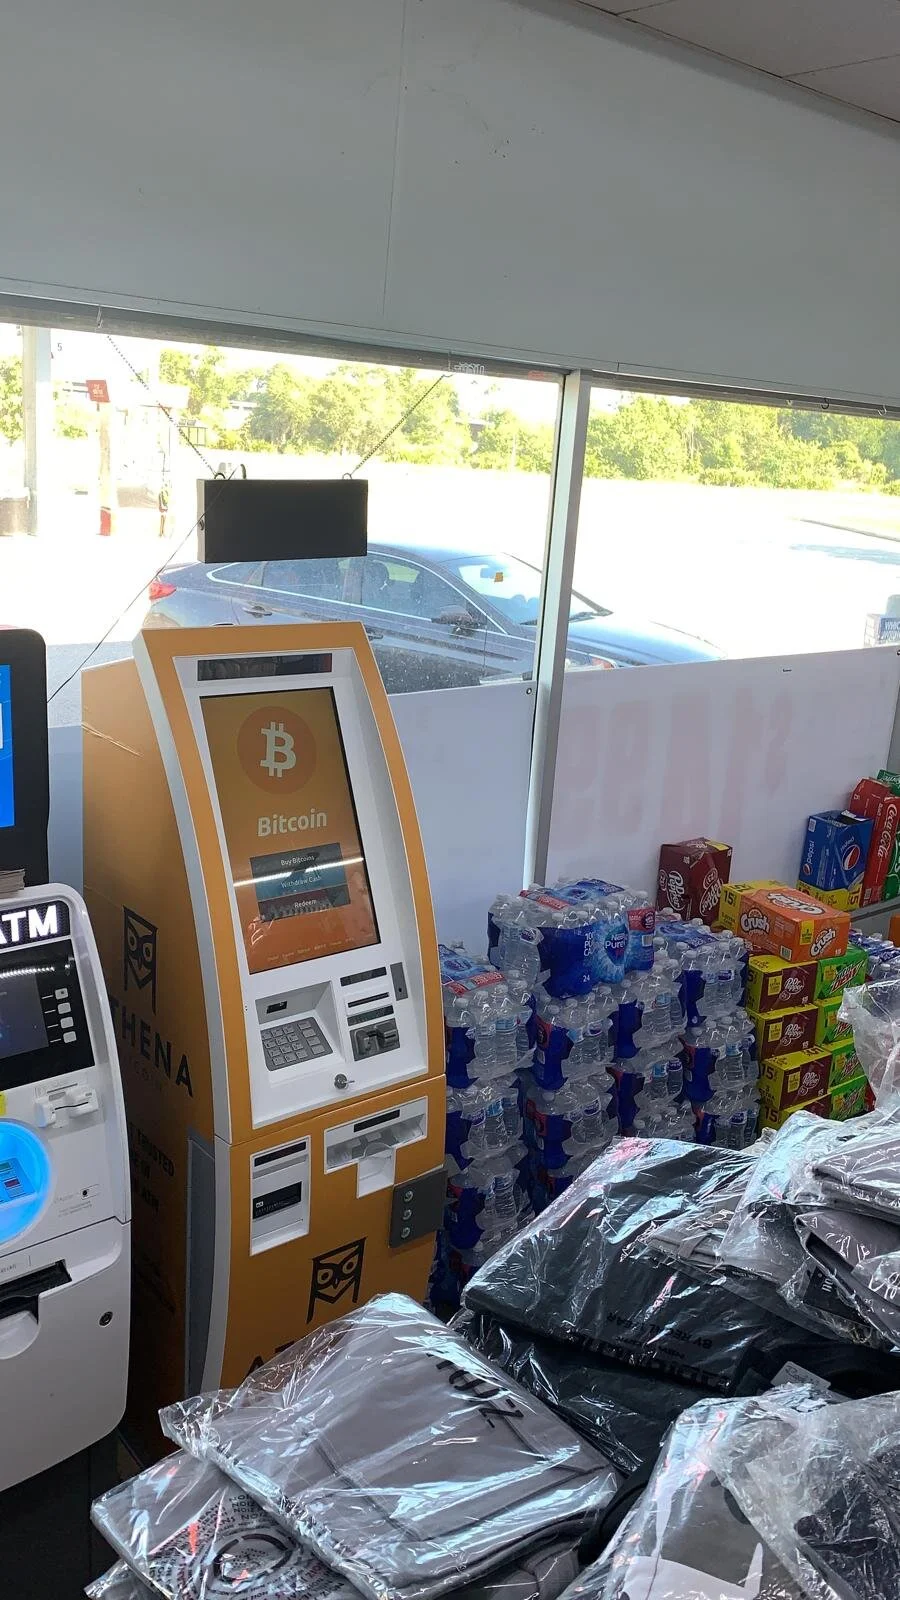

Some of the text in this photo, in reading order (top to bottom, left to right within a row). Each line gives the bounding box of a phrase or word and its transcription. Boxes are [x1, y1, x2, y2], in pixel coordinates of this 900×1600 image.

[257, 808, 328, 837] Bitcoin
[280, 854, 315, 867] Buy Bitcoins
[806, 840, 815, 865] pepsi
[280, 875, 322, 889] Withdraw Cash
[294, 899, 317, 908] Redeem
[723, 891, 735, 905] 15
[740, 912, 770, 935] Crush
[809, 928, 836, 958] Crush
[764, 1106, 778, 1123] 15
